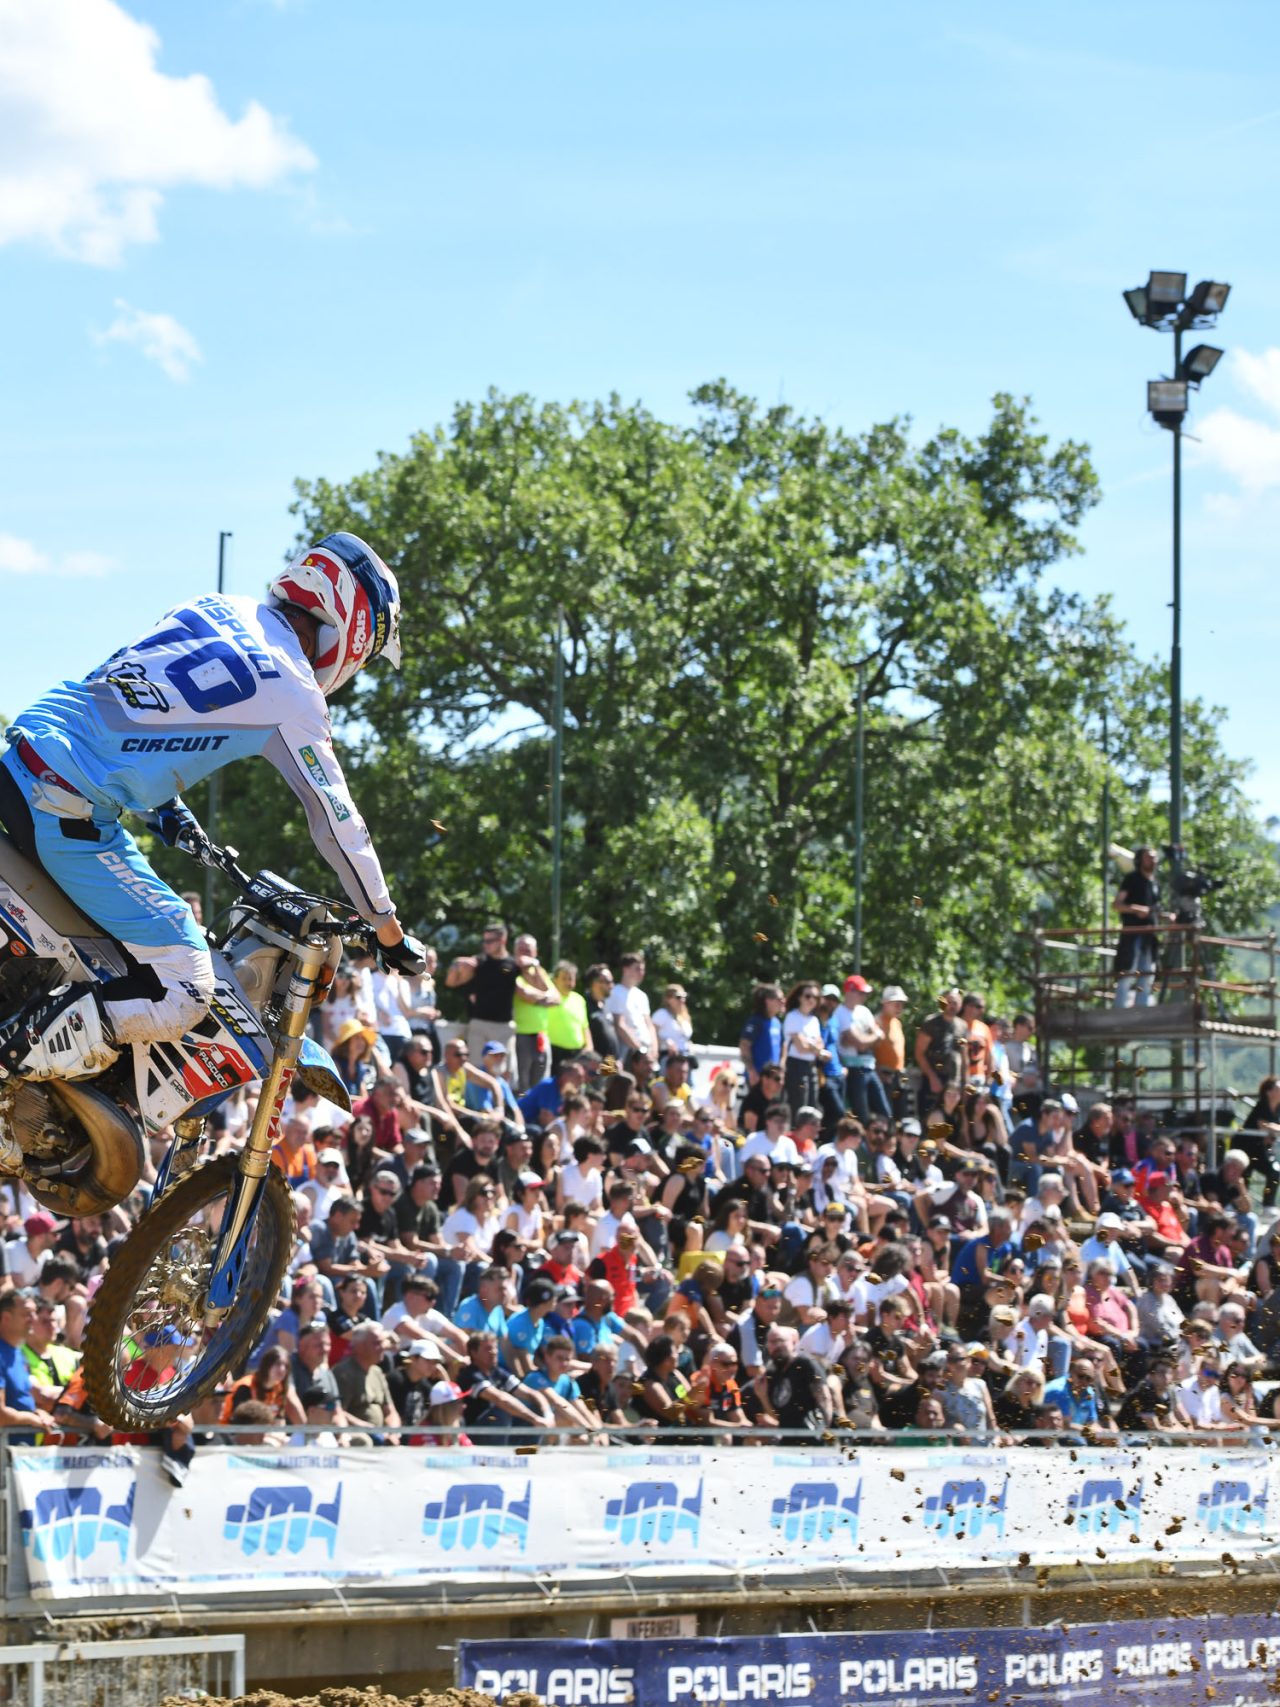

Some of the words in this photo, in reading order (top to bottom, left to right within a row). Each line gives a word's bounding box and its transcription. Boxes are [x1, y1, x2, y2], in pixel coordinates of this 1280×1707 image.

[130, 607, 258, 714] 70
[120, 735, 230, 753] CIRCUIT
[475, 1668, 635, 1706] POLARIS
[667, 1662, 811, 1703] POLARIS
[840, 1655, 978, 1695] POLARIS
